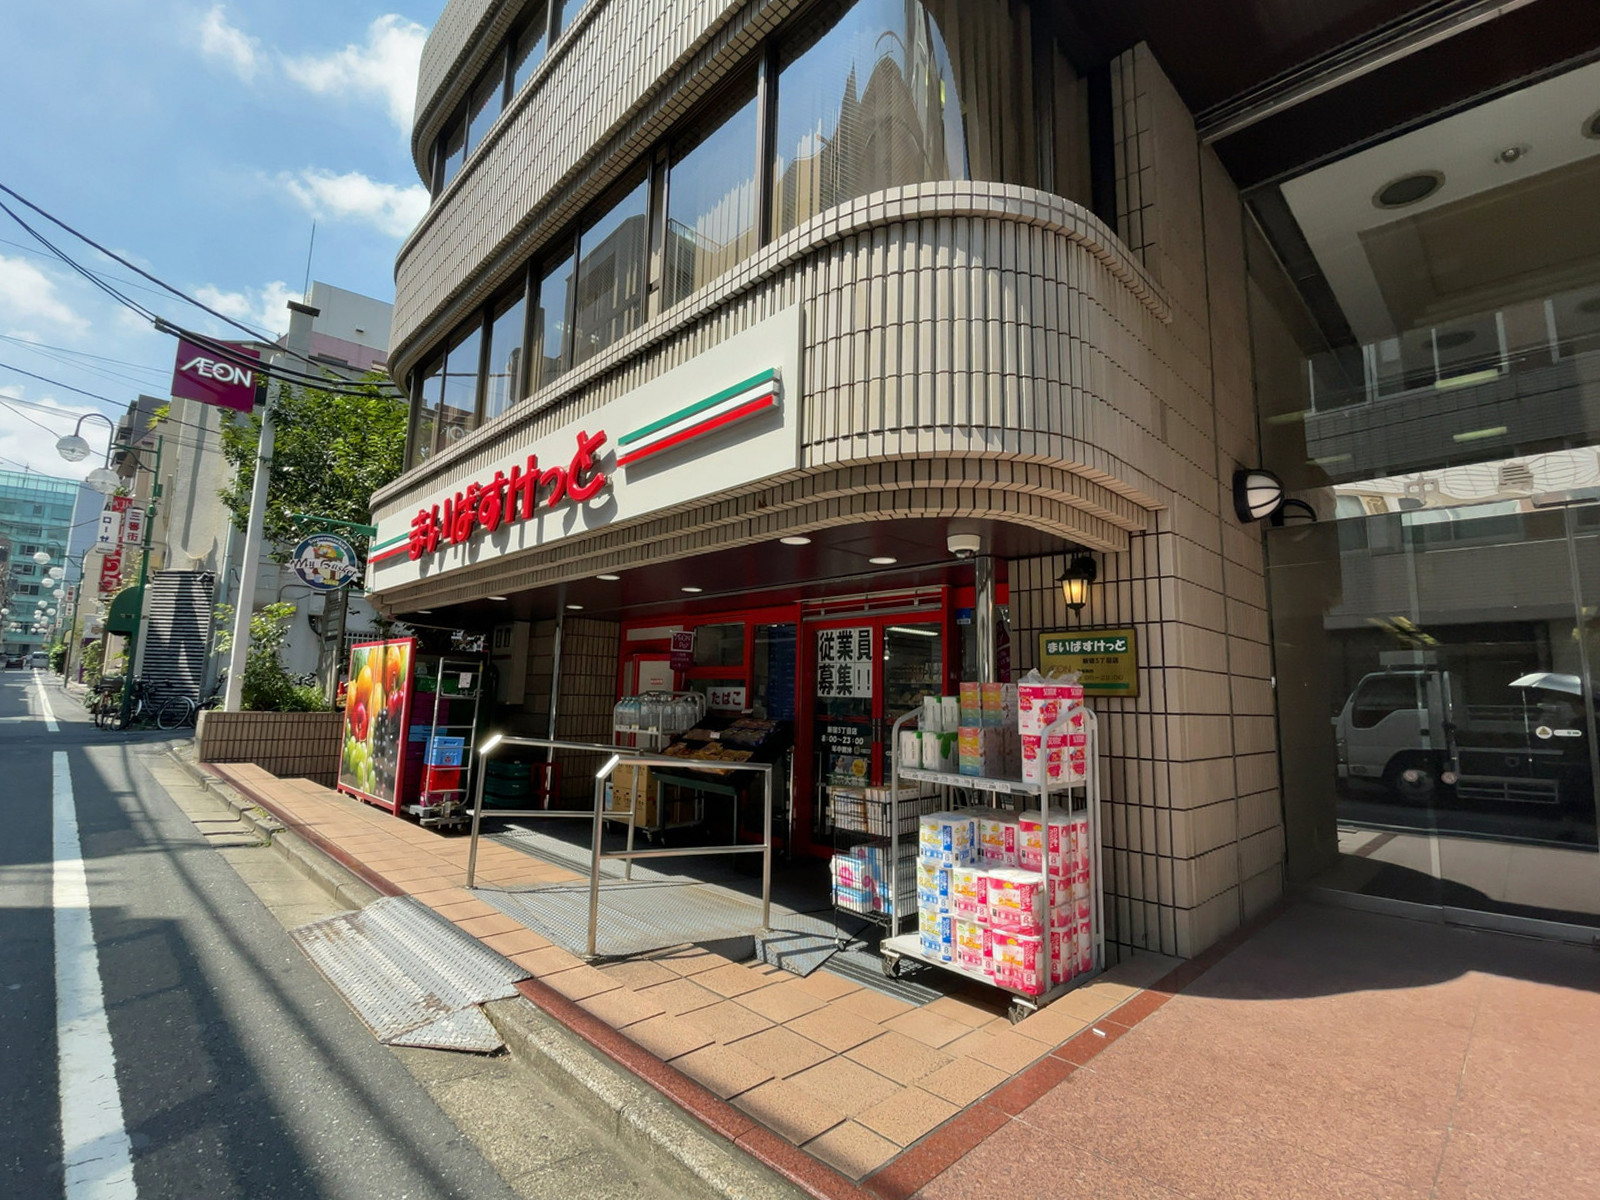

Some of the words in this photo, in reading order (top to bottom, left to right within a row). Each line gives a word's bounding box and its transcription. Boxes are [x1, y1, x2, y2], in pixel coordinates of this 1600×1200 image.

[408, 429, 608, 561] まいばすけっと
[819, 629, 872, 661] 従業員
[1047, 639, 1127, 654] まいばすけっと
[711, 690, 742, 706] たばこ
